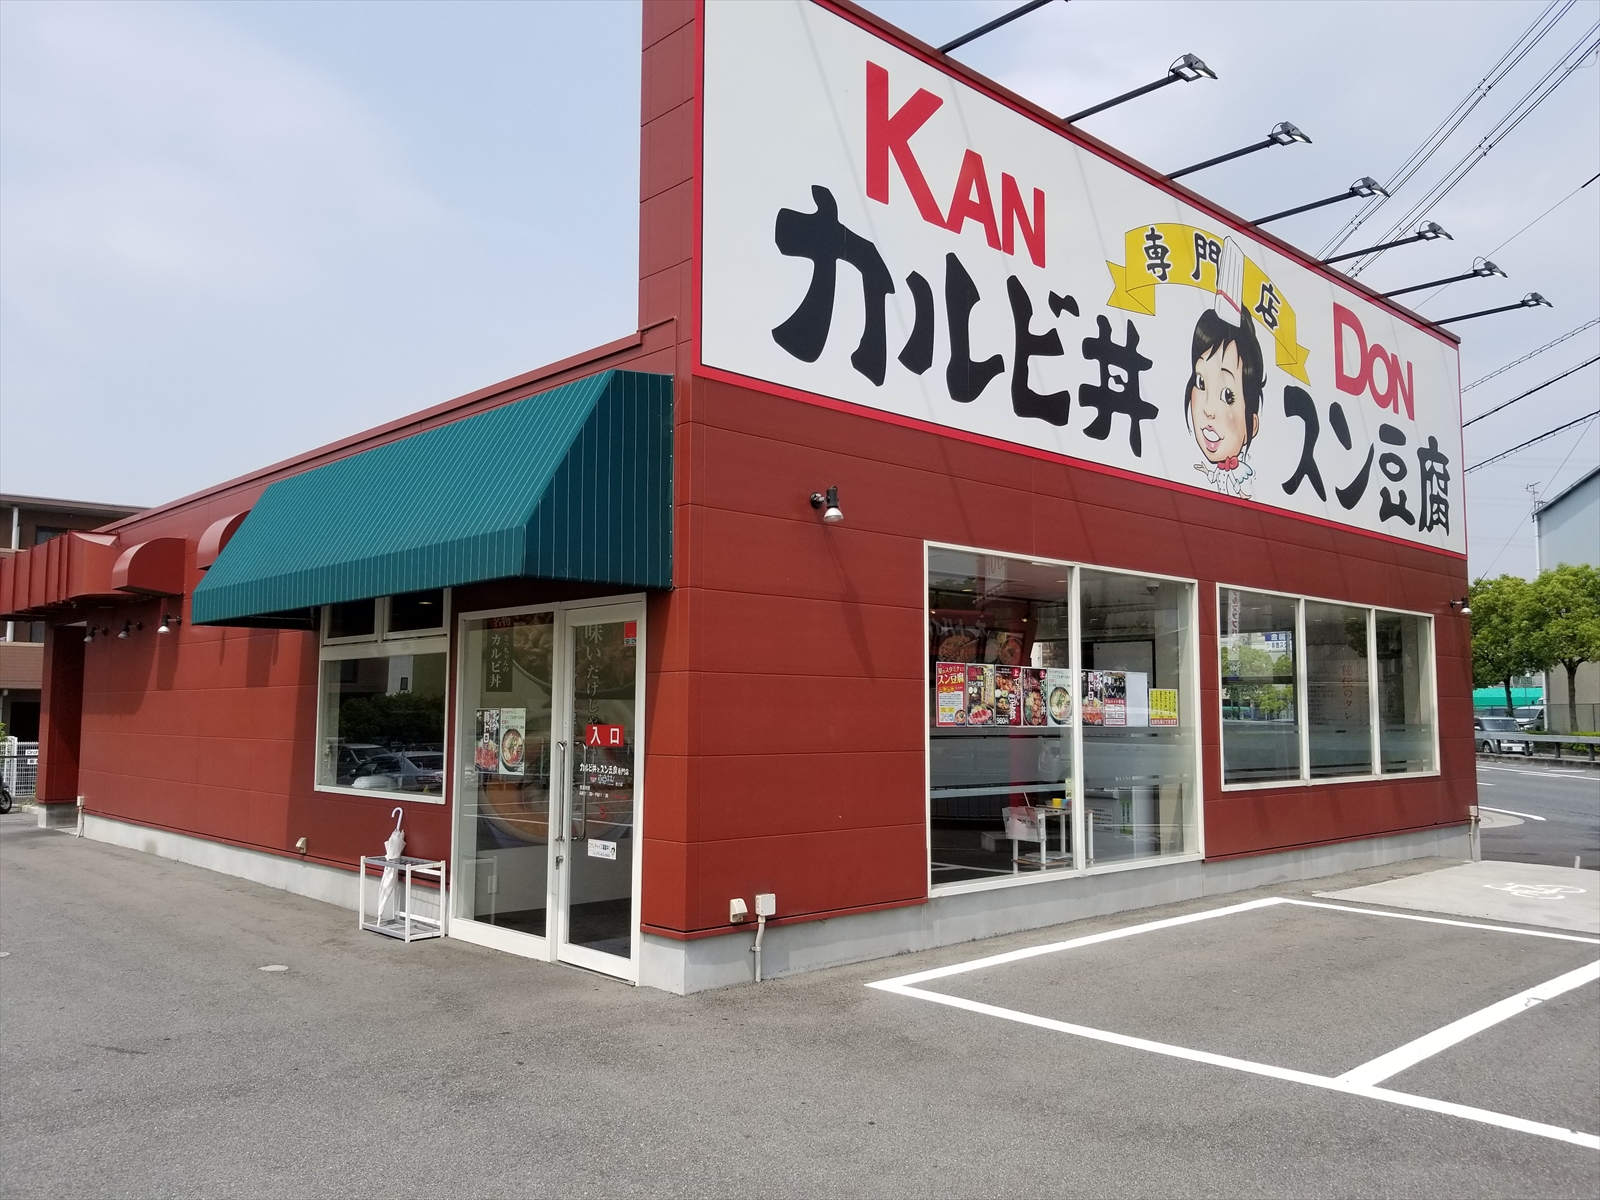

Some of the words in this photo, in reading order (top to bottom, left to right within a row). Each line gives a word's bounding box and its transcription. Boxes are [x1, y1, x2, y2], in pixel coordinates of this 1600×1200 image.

[866, 61, 1046, 268] KAN
[772, 185, 1158, 457] カルビ丼
[1333, 302, 1415, 421] DON
[1283, 385, 1450, 537] スン豆腐
[490, 633, 501, 688] カルビ丼
[590, 726, 620, 745] 入口
